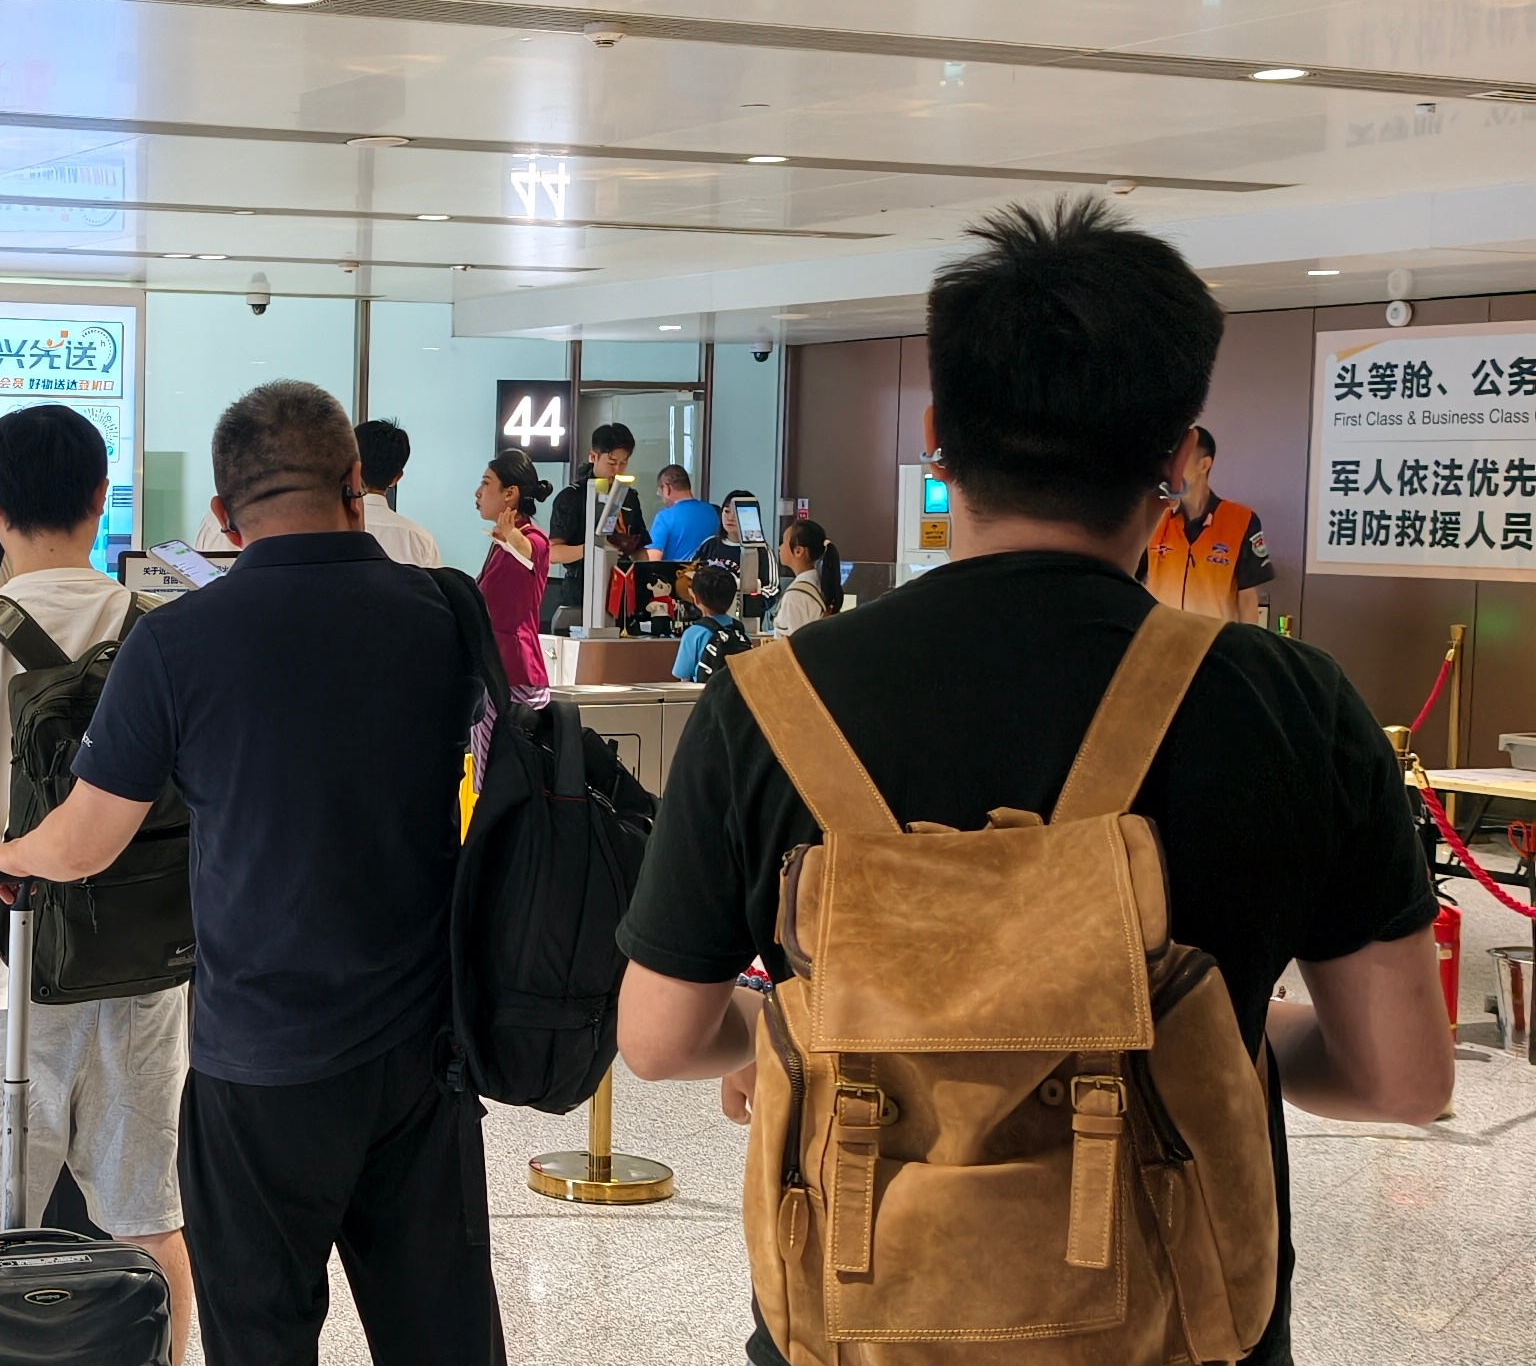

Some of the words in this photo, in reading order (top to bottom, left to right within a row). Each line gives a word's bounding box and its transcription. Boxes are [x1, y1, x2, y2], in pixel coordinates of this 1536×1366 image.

[504, 395, 566, 447] 44
[1333, 412, 1362, 427] First
[1366, 411, 1403, 426] Class
[1407, 411, 1417, 425] &
[1422, 410, 1485, 425] Business
[1489, 408, 1530, 425] Class
[1329, 458, 1536, 498] 军人依法优先
[1328, 509, 1533, 551] 消防救援人员
